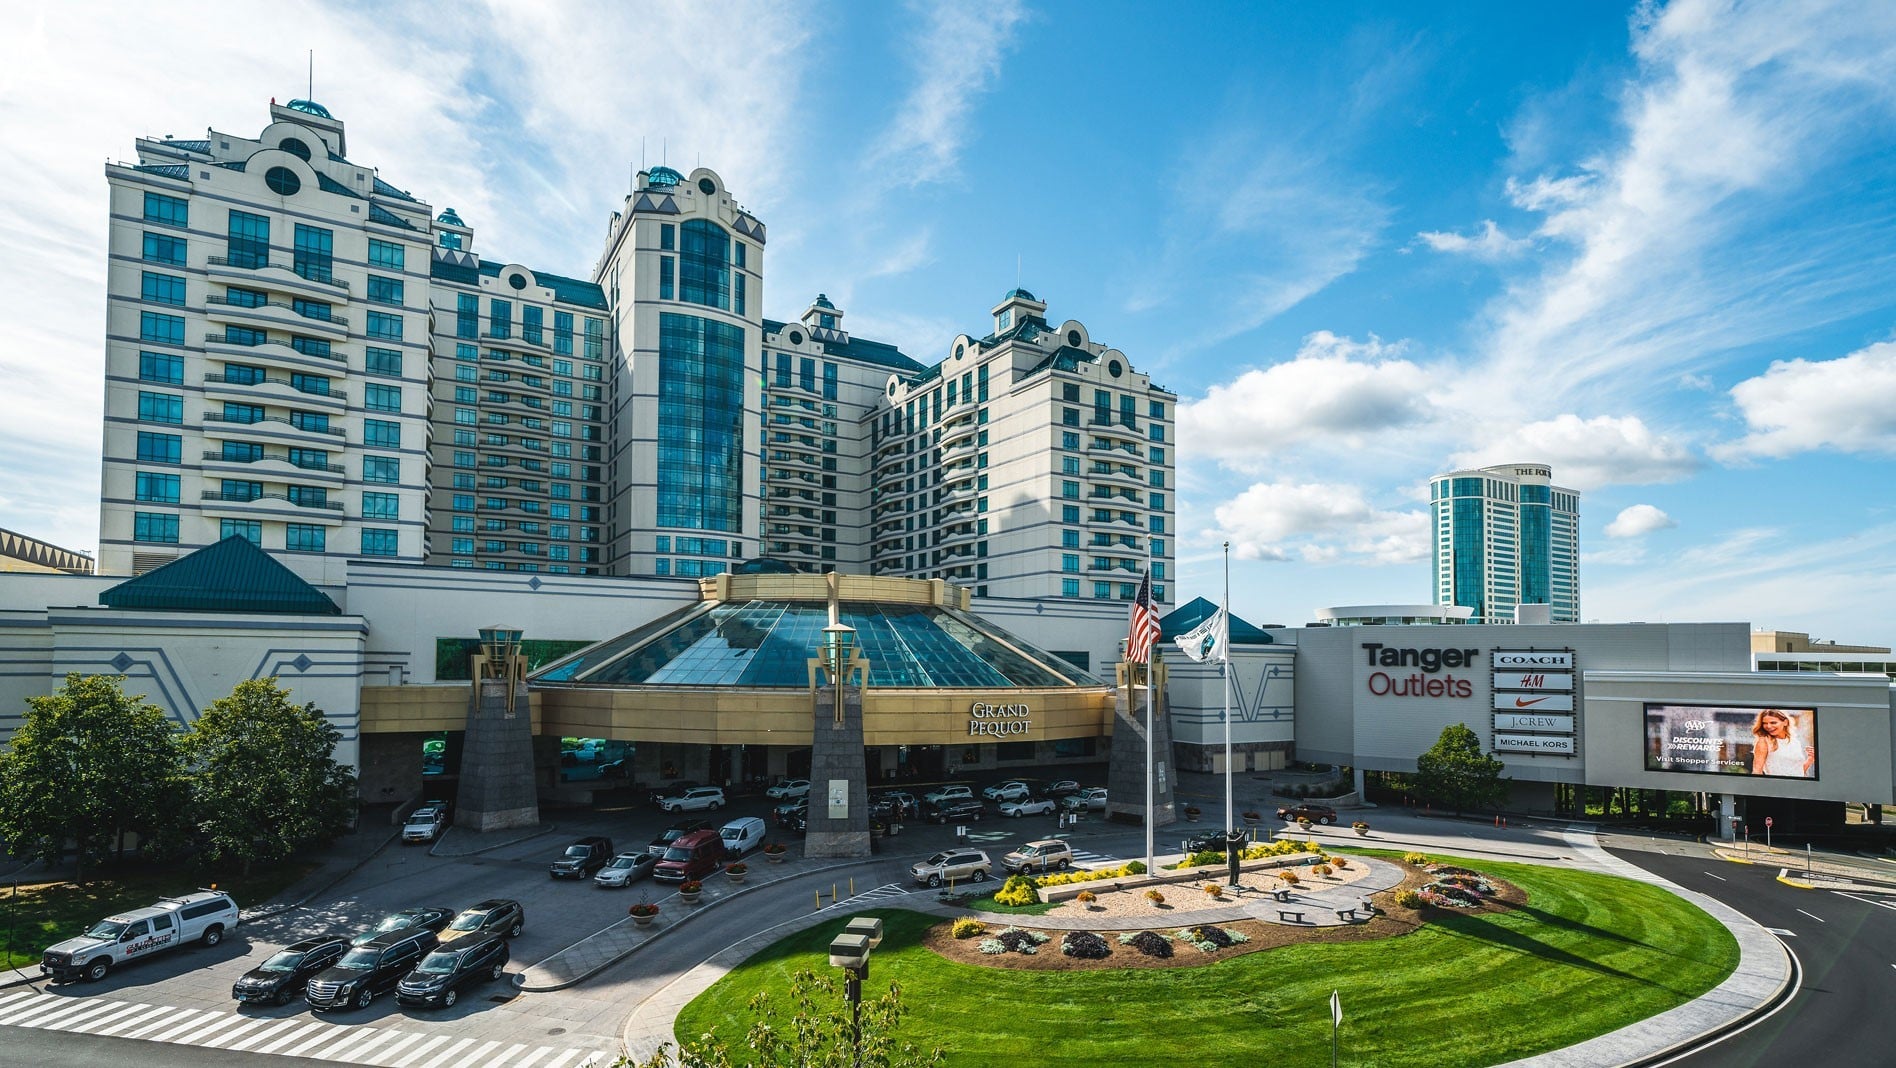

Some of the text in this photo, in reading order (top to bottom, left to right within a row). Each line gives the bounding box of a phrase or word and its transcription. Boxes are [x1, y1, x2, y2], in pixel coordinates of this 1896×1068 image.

[1514, 468, 1533, 476] THE
[1361, 643, 1479, 673] Tanger
[1500, 656, 1565, 665] COACH
[1368, 671, 1472, 698] Outlets
[1520, 674, 1544, 688] H&M
[972, 702, 1029, 718] GRAND
[969, 720, 1031, 738] PEQUOT
[1500, 739, 1568, 748] MICHAEL KORS
[1673, 736, 1724, 745] DISCOUNTS
[1675, 757, 1709, 765] Shopper
